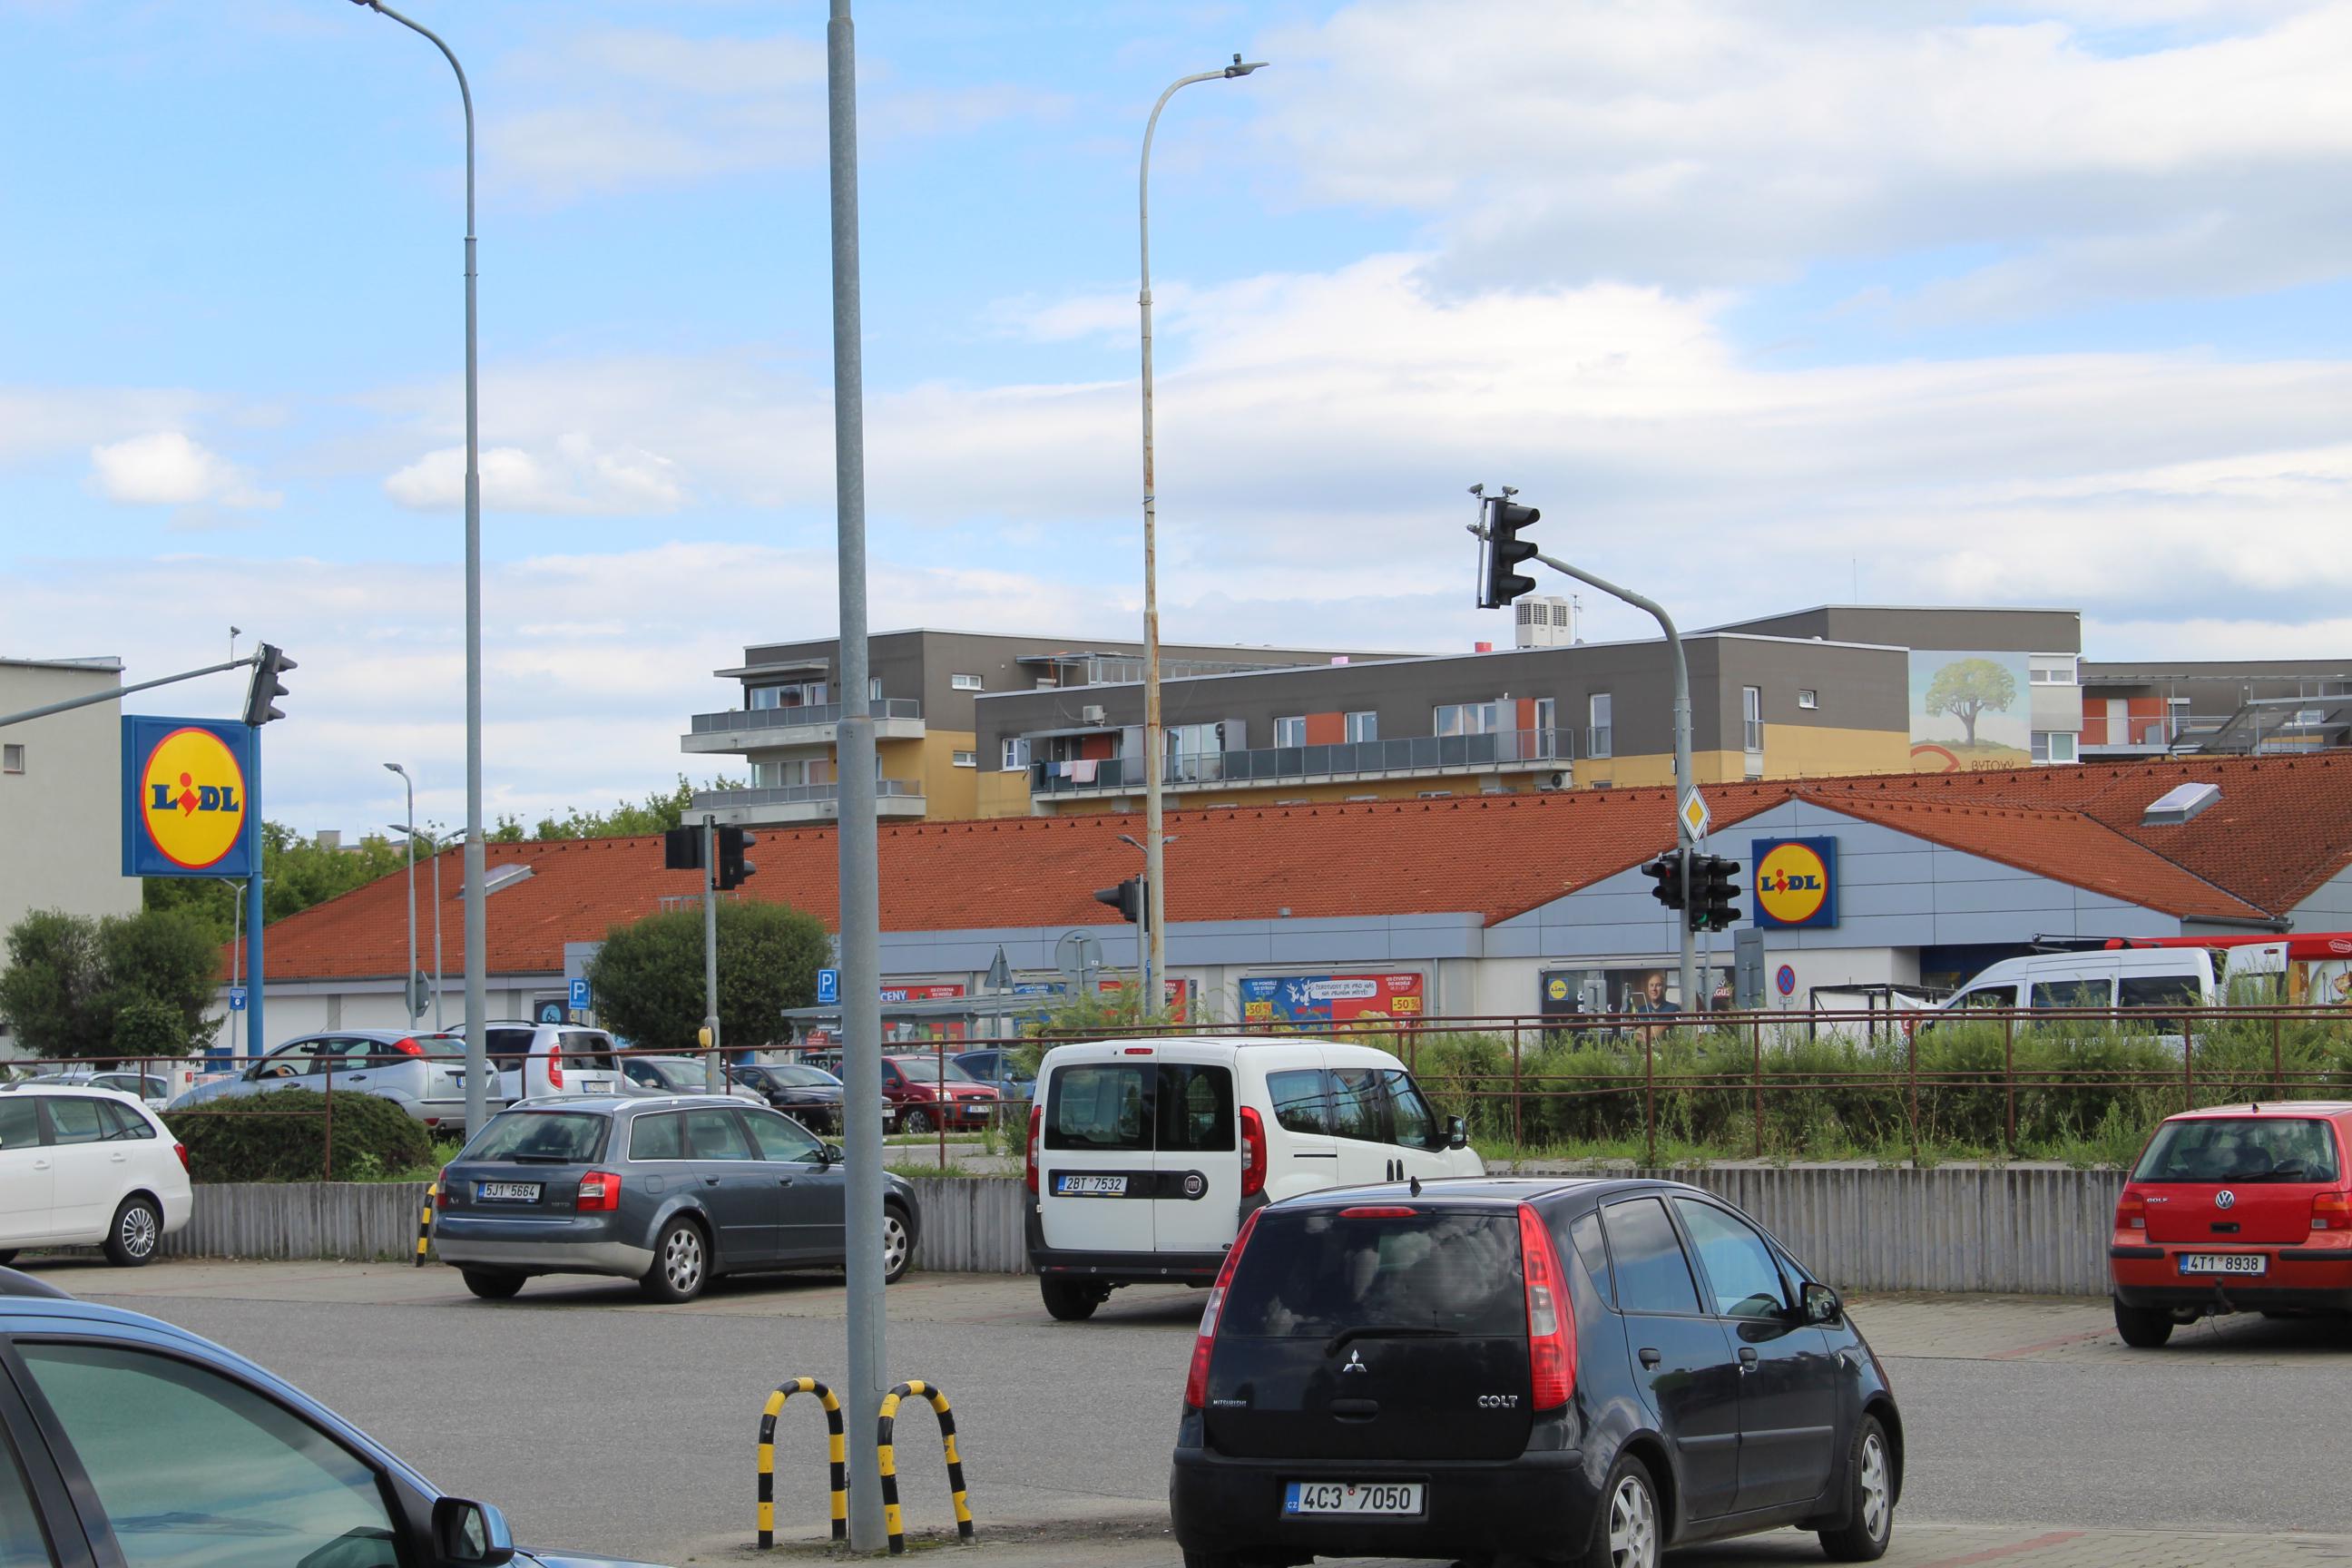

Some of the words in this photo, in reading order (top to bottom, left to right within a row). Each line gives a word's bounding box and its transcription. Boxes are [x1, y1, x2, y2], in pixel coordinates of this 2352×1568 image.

[822, 974, 832, 992] P
[574, 982, 585, 999] P
[881, 990, 906, 1002] CENY
[1394, 999, 1409, 1009] -50
[486, 1184, 505, 1196] 5J1
[511, 1185, 534, 1197] 5664
[1066, 1178, 1087, 1190] 2BT
[1094, 1178, 1122, 1191] 7532
[2190, 1256, 2214, 1269] 4T1
[2225, 1257, 2259, 1270] 8938
[1477, 1395, 1518, 1408] COLT
[1288, 1502, 1298, 1510] CZ
[1303, 1486, 1343, 1509] 4C3
[1359, 1486, 1411, 1510] 7050
